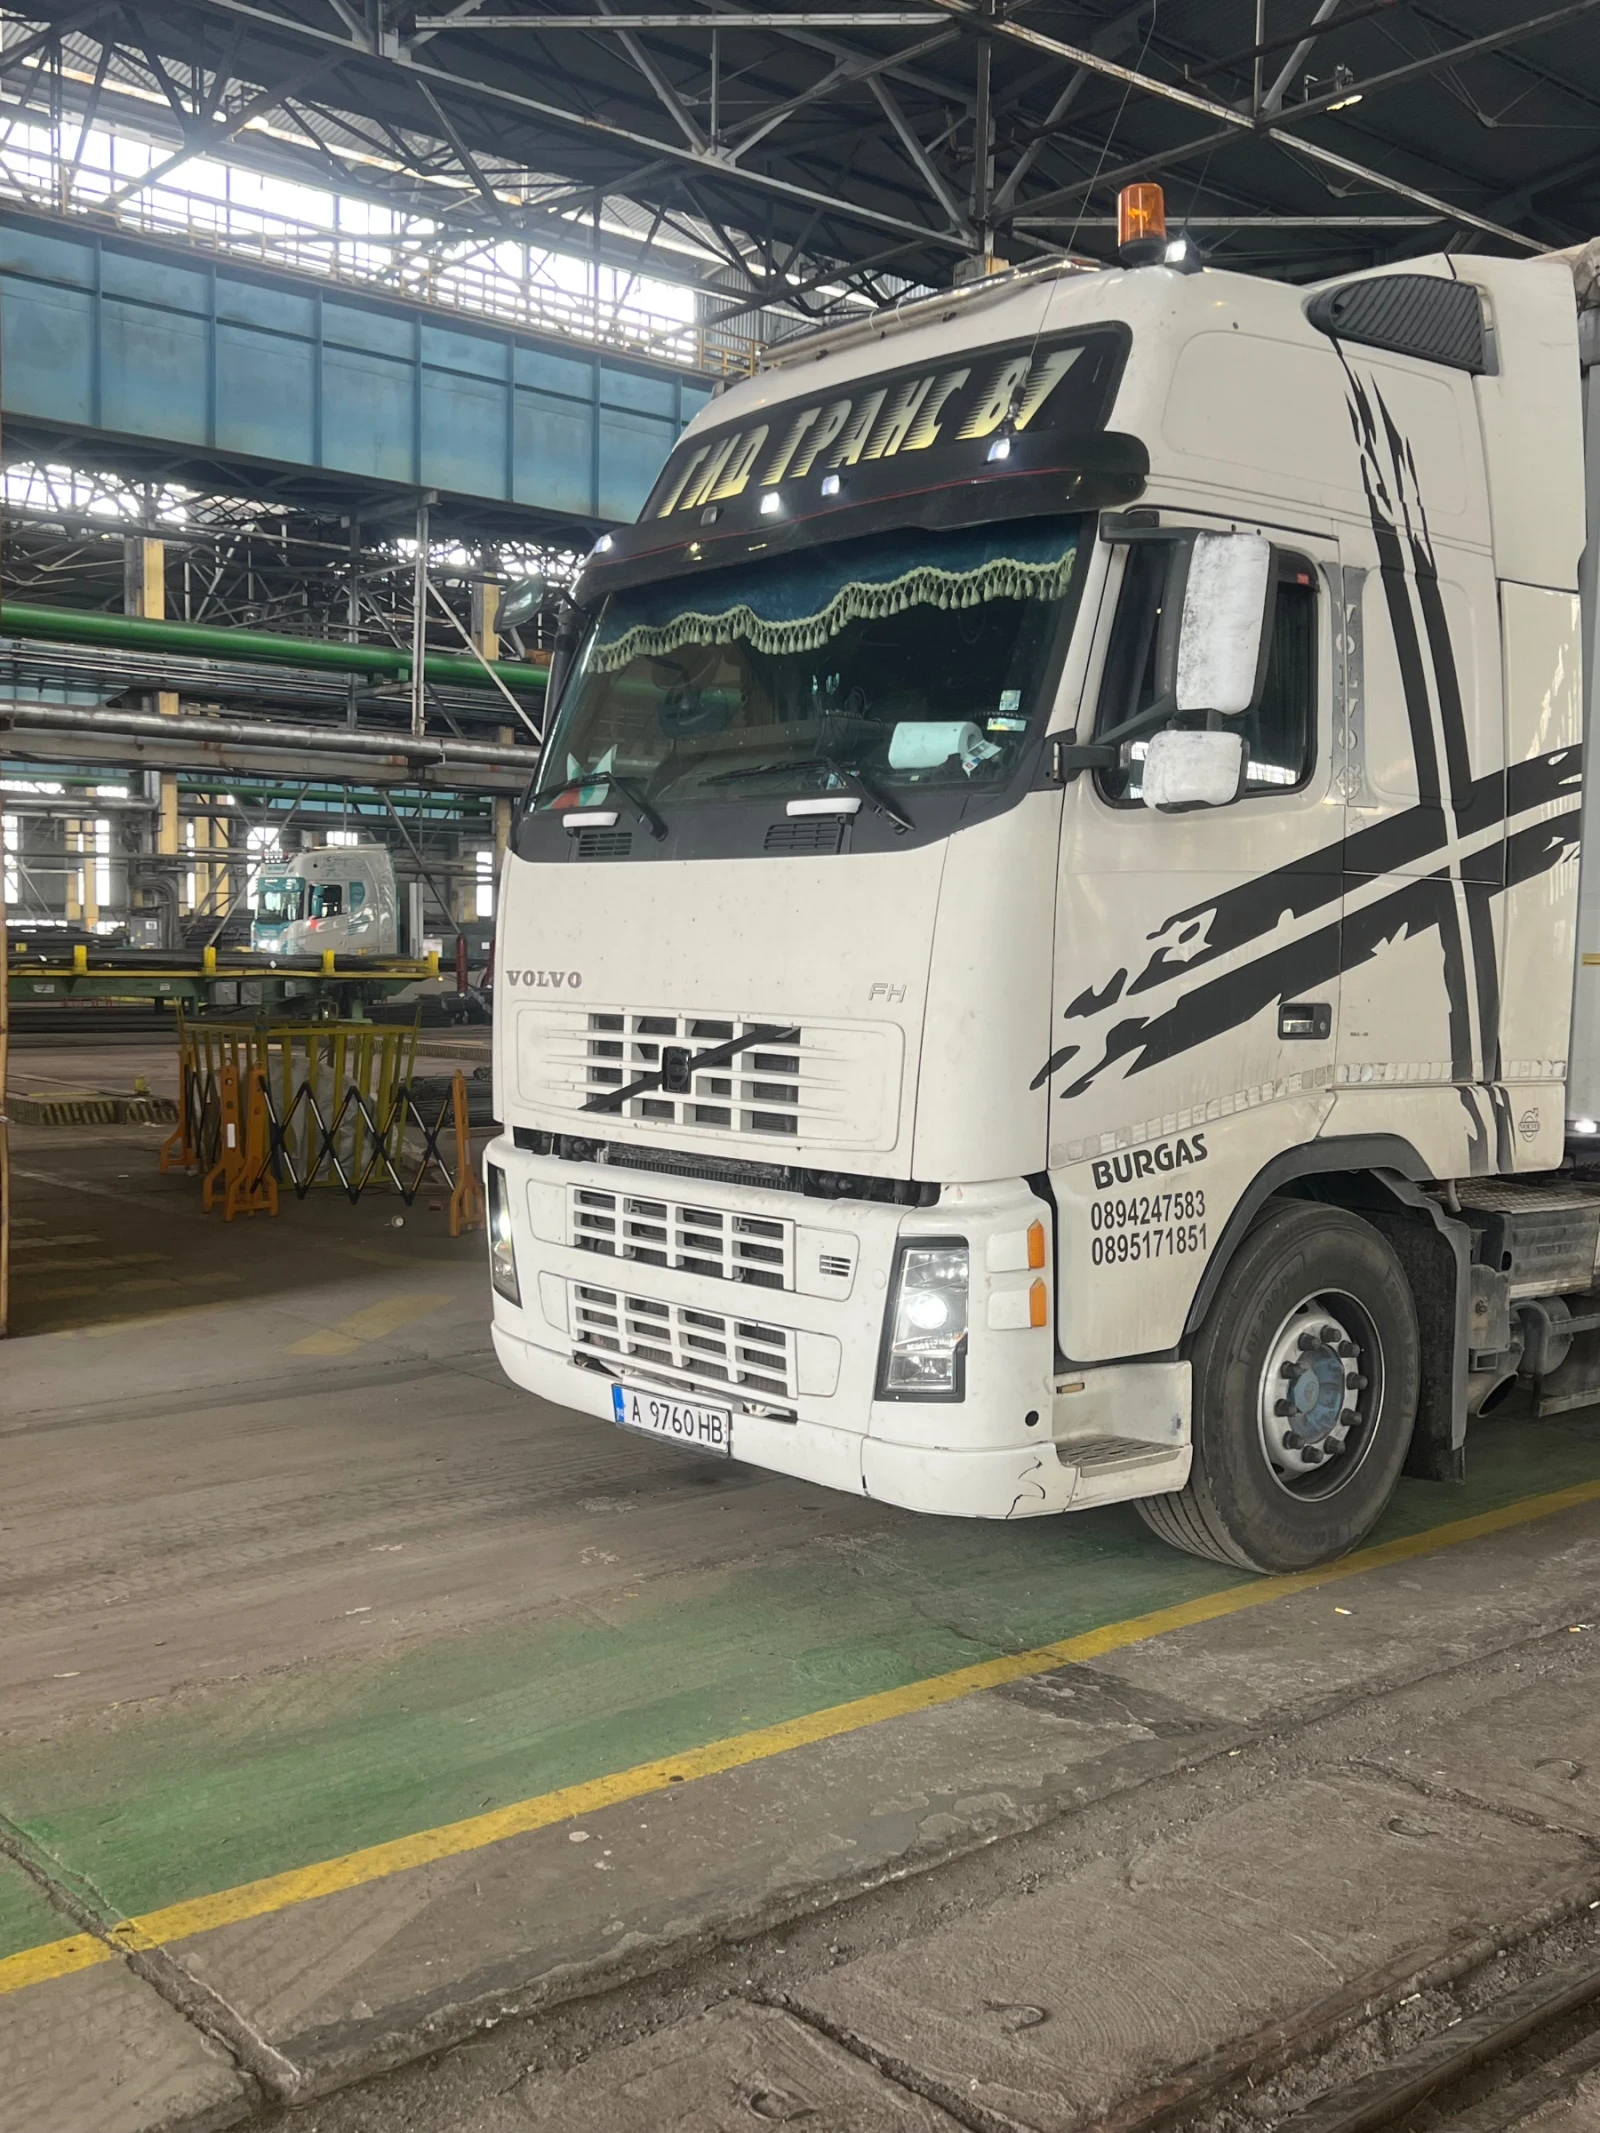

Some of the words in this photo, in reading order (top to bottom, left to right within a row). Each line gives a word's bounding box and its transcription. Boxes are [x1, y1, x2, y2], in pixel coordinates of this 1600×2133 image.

[759, 367, 972, 486] ТРАНС
[1334, 601, 1358, 750] VOLVO
[506, 970, 582, 989] VOLVO
[868, 982, 907, 1003] FH
[1091, 1133, 1208, 1190] BURGAS
[1091, 1190, 1206, 1231] 0894247583
[1092, 1223, 1207, 1266] 0895171851
[632, 1396, 641, 1423] A
